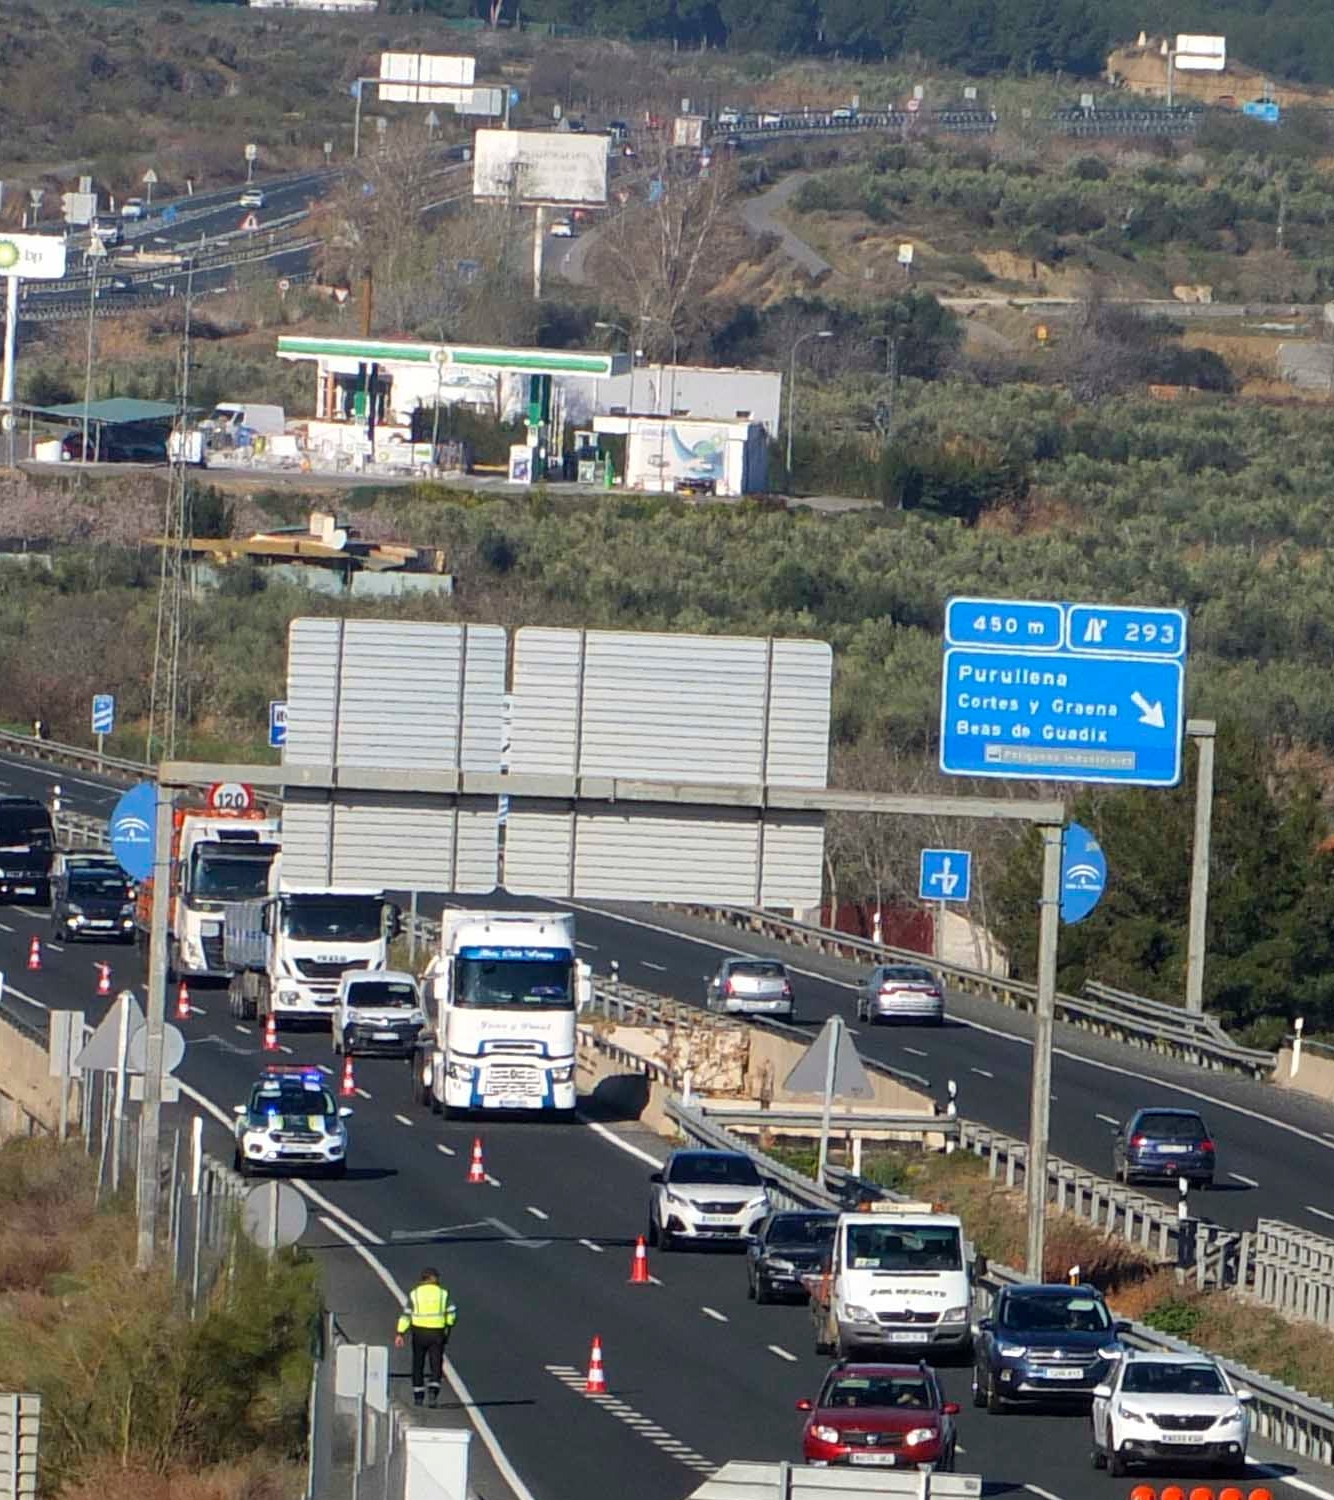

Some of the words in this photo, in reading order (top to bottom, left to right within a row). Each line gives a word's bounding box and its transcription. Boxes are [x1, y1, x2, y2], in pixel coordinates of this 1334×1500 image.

[972, 615, 1018, 634] 450
[1027, 622, 1045, 635] m
[1124, 622, 1175, 644] 293
[958, 664, 1068, 687] Purullena
[957, 693, 1019, 712] Cortes
[1029, 700, 1040, 715] y
[1051, 699, 1118, 717] Graena
[956, 719, 1002, 737] Beas
[1011, 723, 1031, 738] de
[1042, 724, 1108, 743] Guadix
[218, 792, 245, 809] 120
